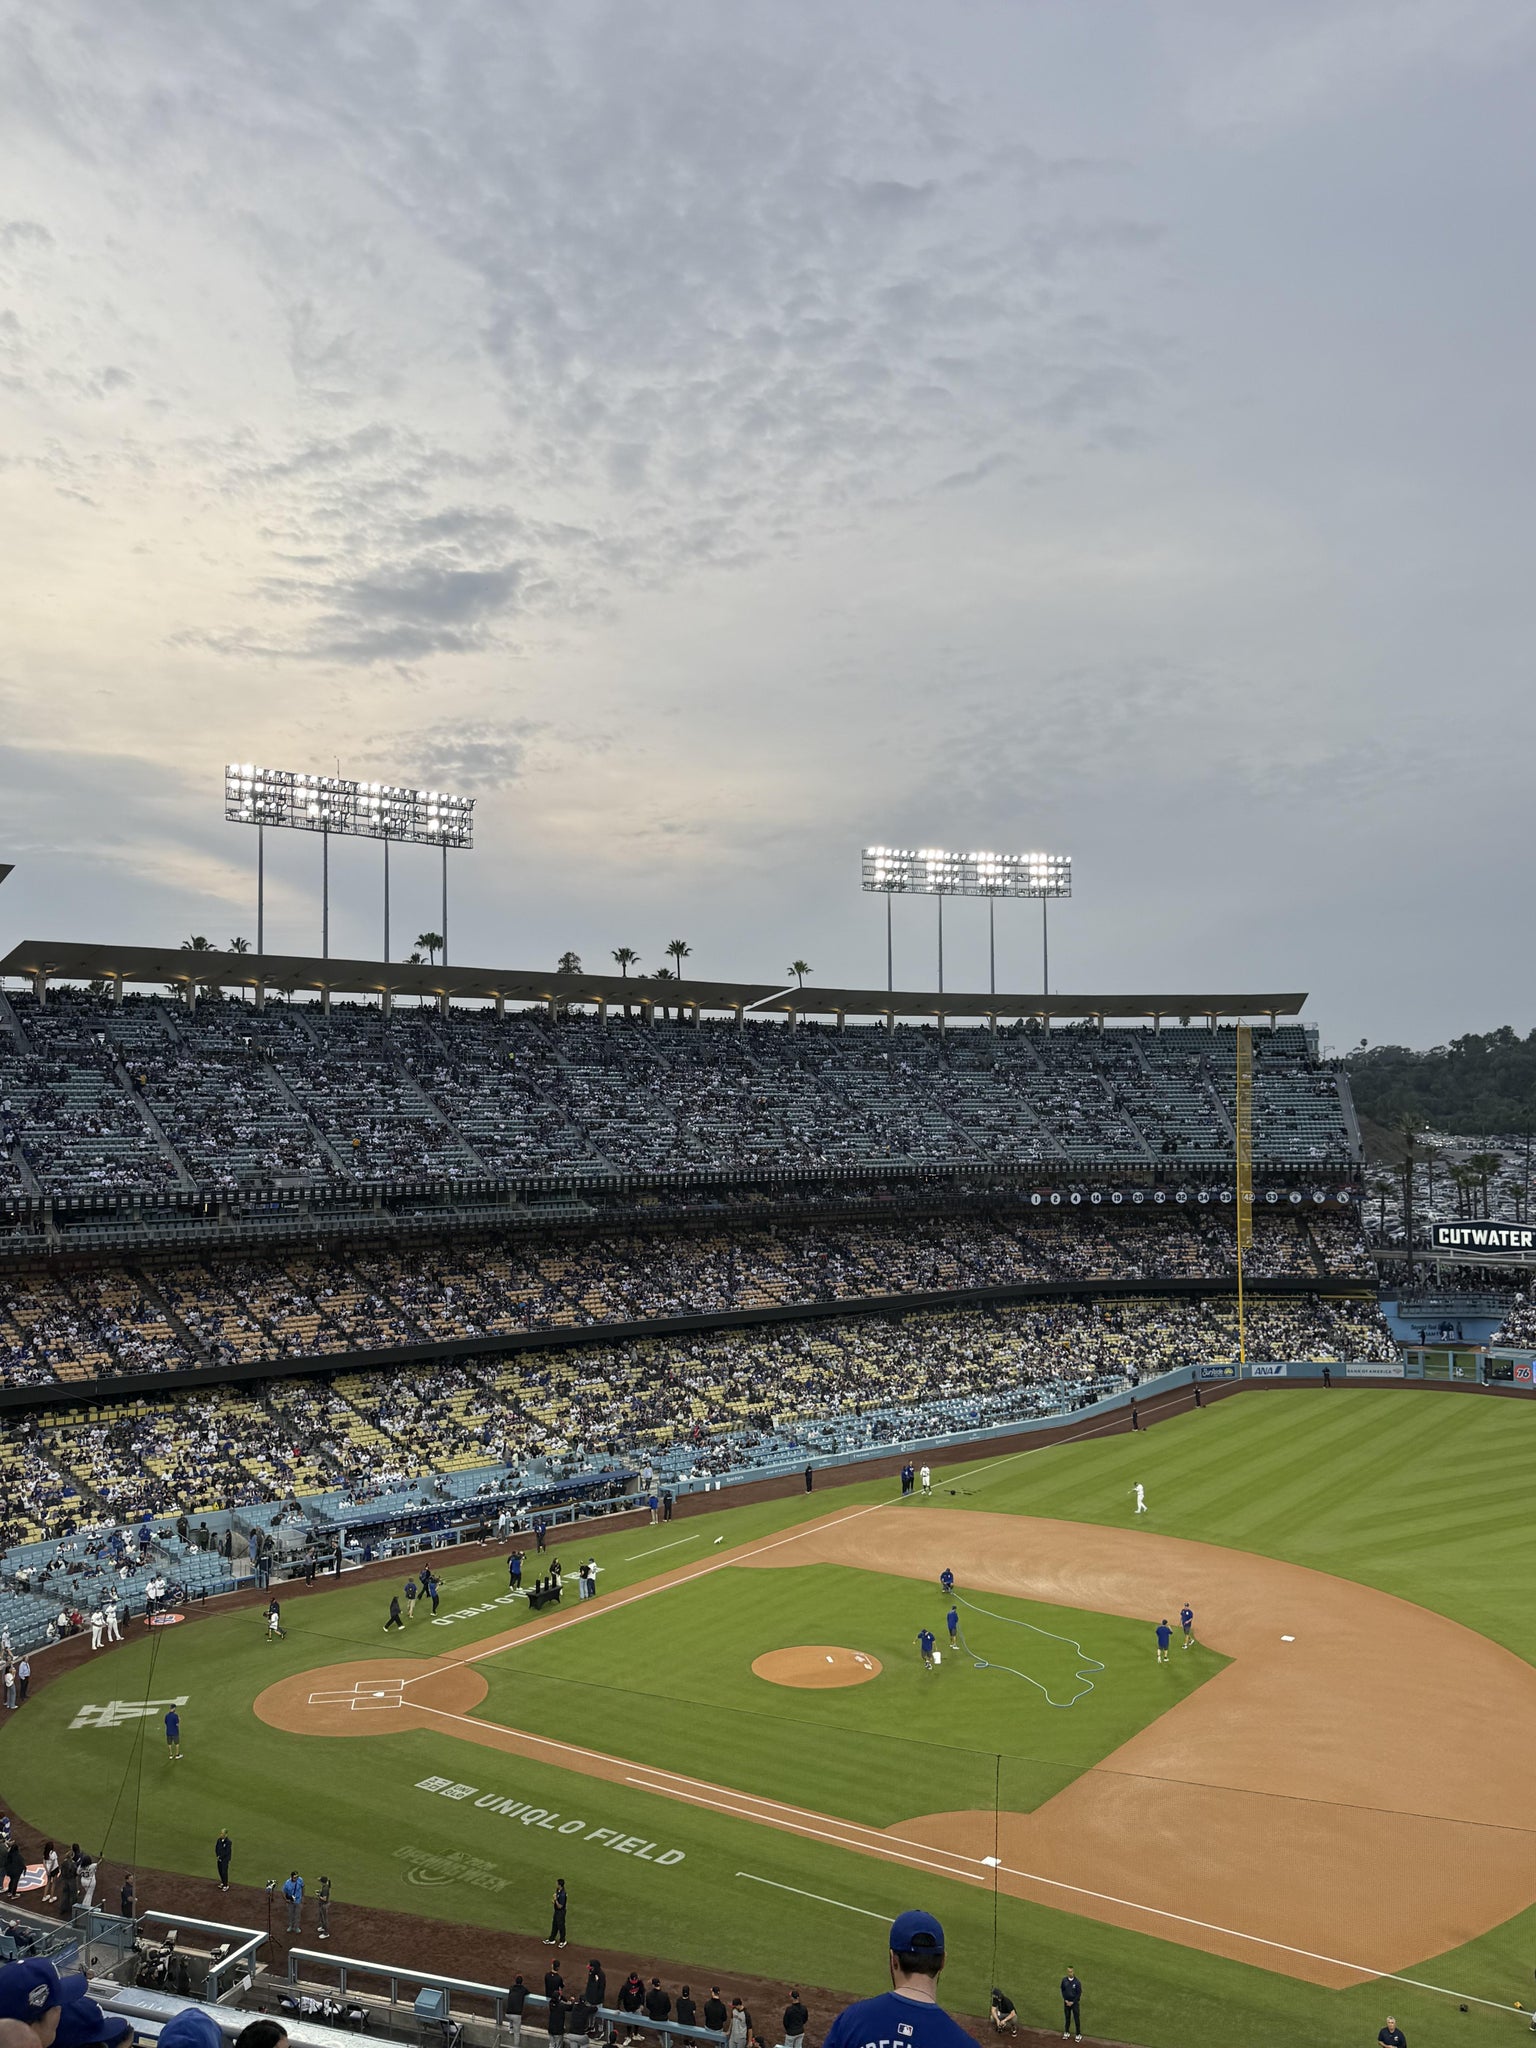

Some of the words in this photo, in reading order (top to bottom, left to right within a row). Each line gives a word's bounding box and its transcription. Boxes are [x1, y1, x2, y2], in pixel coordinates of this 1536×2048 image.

[1438, 1228, 1533, 1247] CUTWATER
[1255, 1367, 1273, 1375] ANA
[1517, 1368, 1530, 1378] 76
[431, 1603, 499, 1627] FIELD
[444, 1789, 465, 1798] QLO
[453, 1785, 473, 1794] UNI
[474, 1793, 586, 1835] UNIQLO
[583, 1827, 686, 1866] FIELD
[391, 1845, 467, 1877] OPENING
[456, 1868, 514, 1893] WEEK
